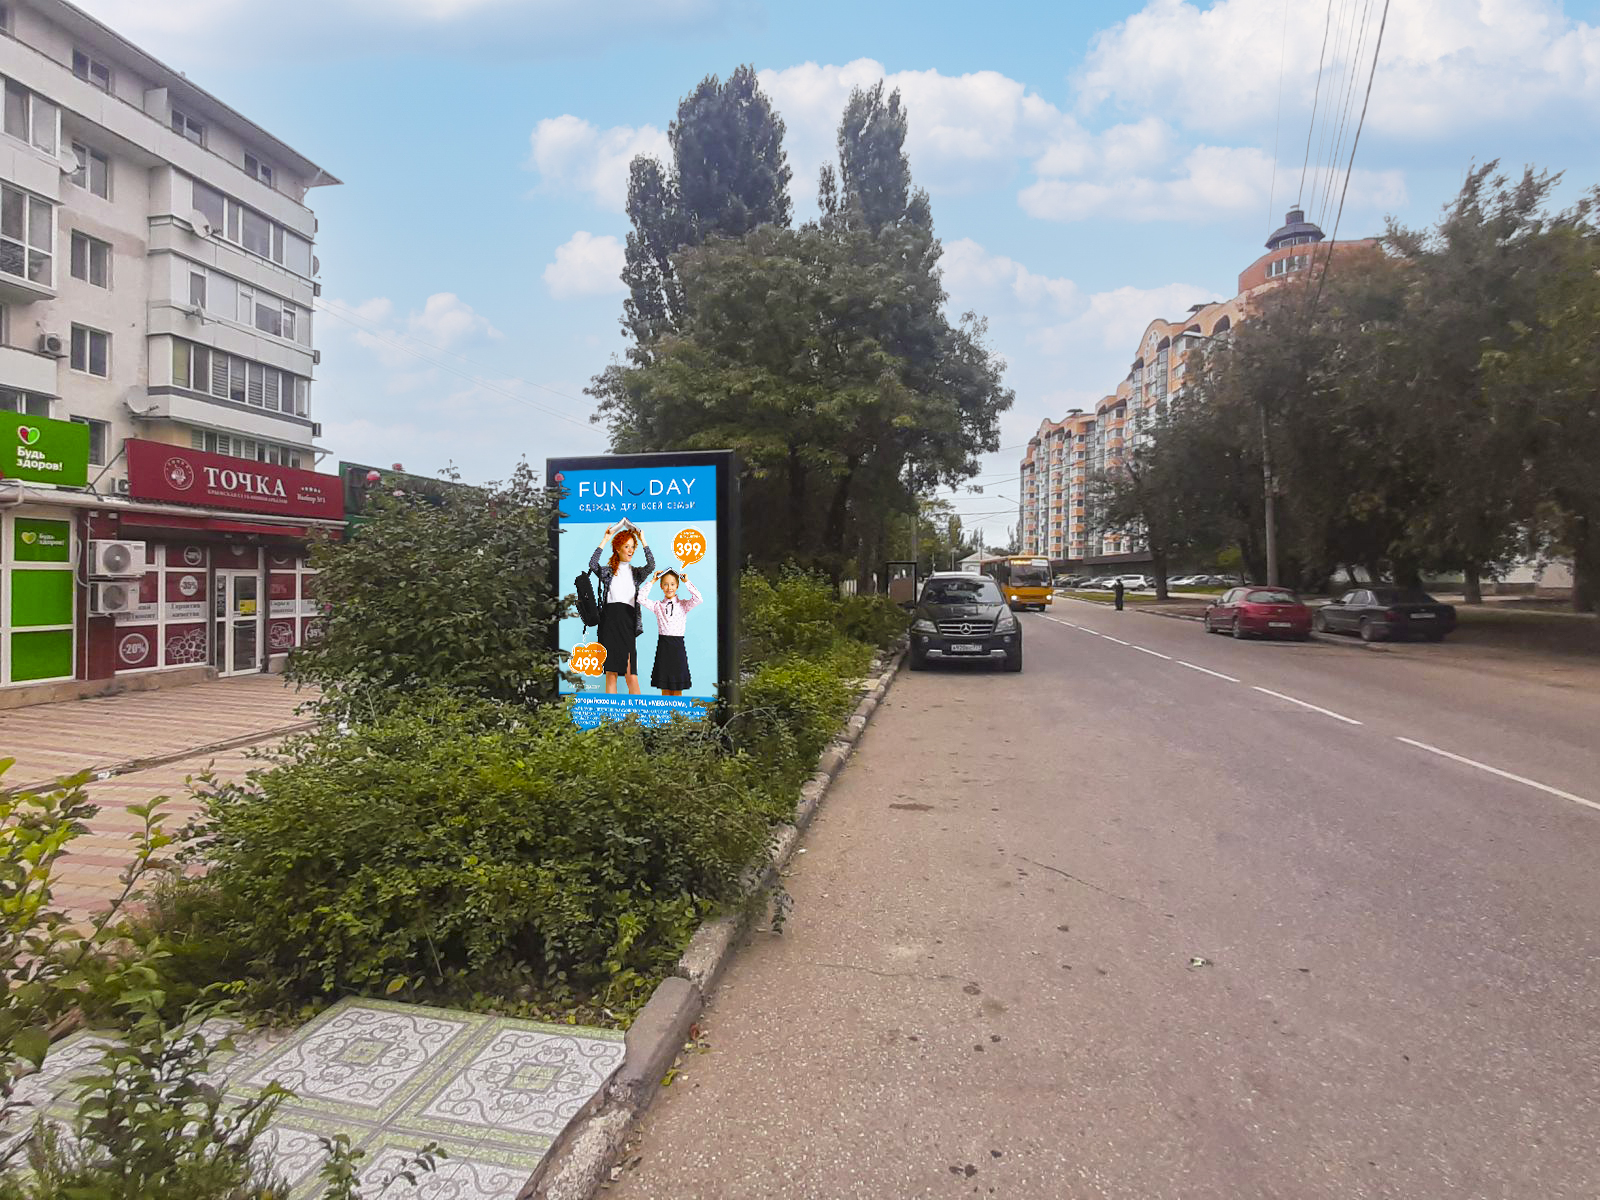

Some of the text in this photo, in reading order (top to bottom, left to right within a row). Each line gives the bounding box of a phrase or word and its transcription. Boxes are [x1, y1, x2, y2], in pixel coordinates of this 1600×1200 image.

[17, 446, 46, 459] Будь
[16, 458, 63, 471] здоров!
[203, 466, 287, 497] ТОЧКА
[578, 478, 696, 498] FUN DAY
[579, 501, 696, 512] ОДЕЖДА ДЛЯ ВСЕЙ СЕМЬИ
[122, 643, 147, 655] -20%
[635, 699, 648, 707] ТРЦ
